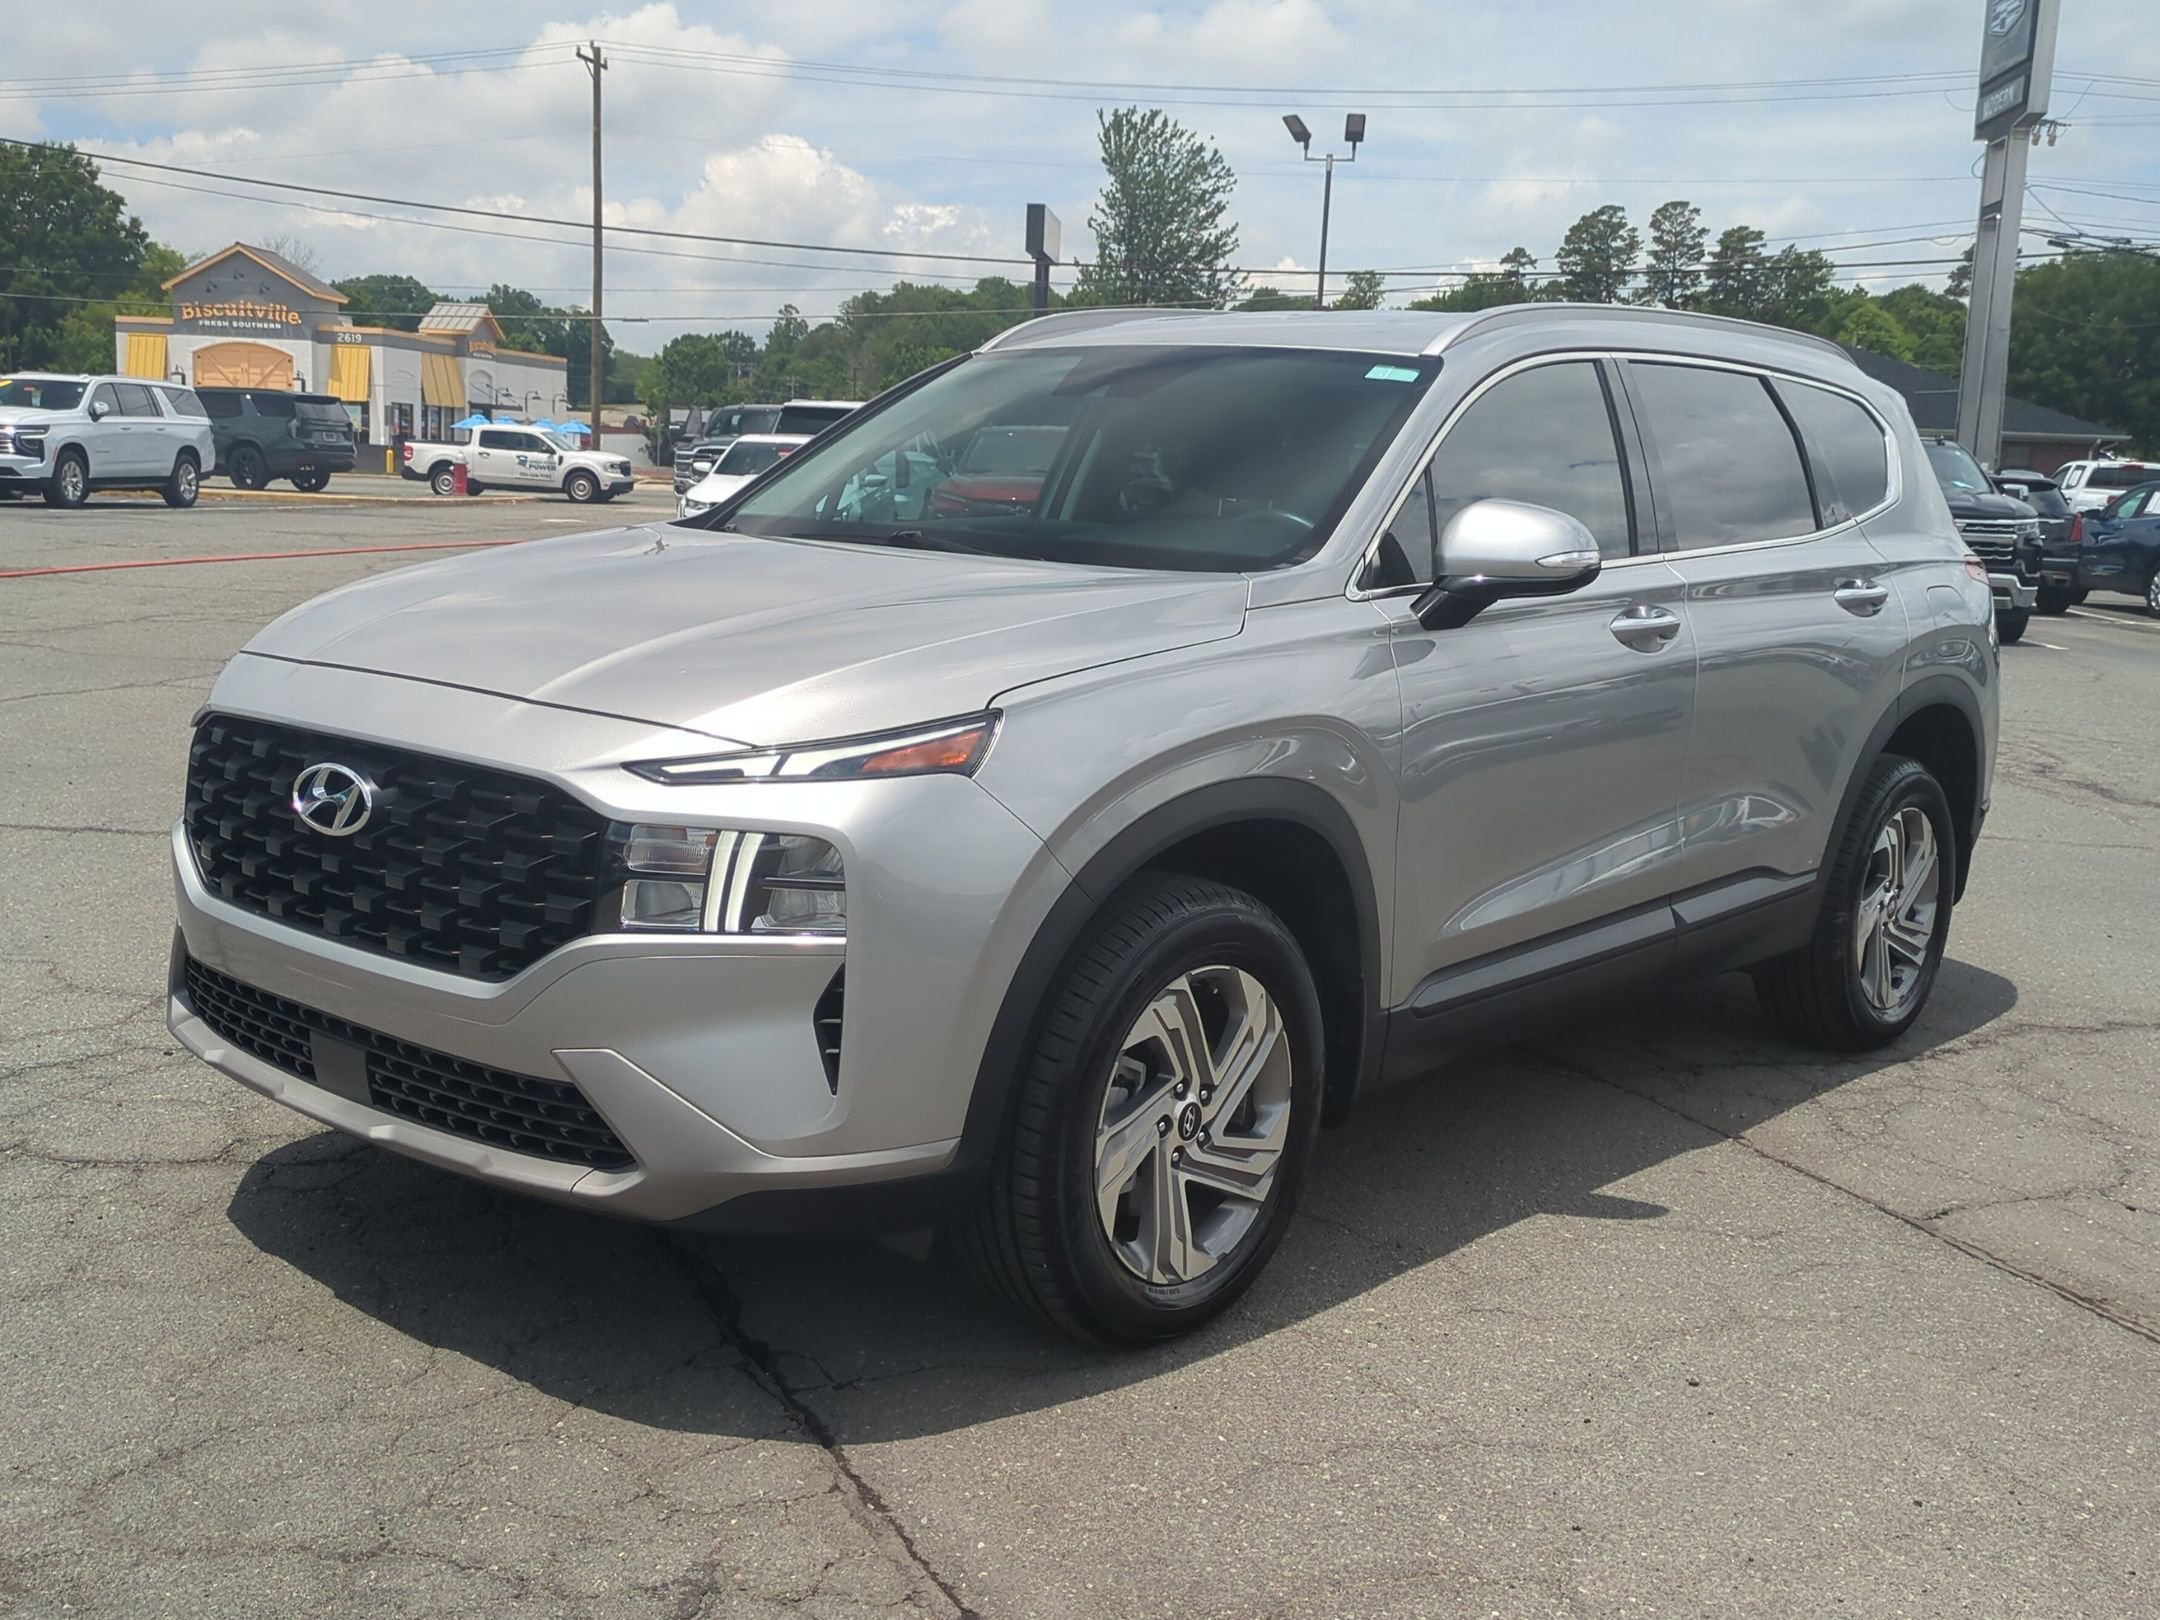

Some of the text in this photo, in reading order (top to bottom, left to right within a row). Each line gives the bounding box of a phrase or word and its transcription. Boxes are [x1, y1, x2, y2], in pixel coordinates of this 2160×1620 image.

[199, 320, 281, 329] FRESH SOUTHERN
[337, 333, 362, 344] 2619
[528, 463, 557, 471] POWER
